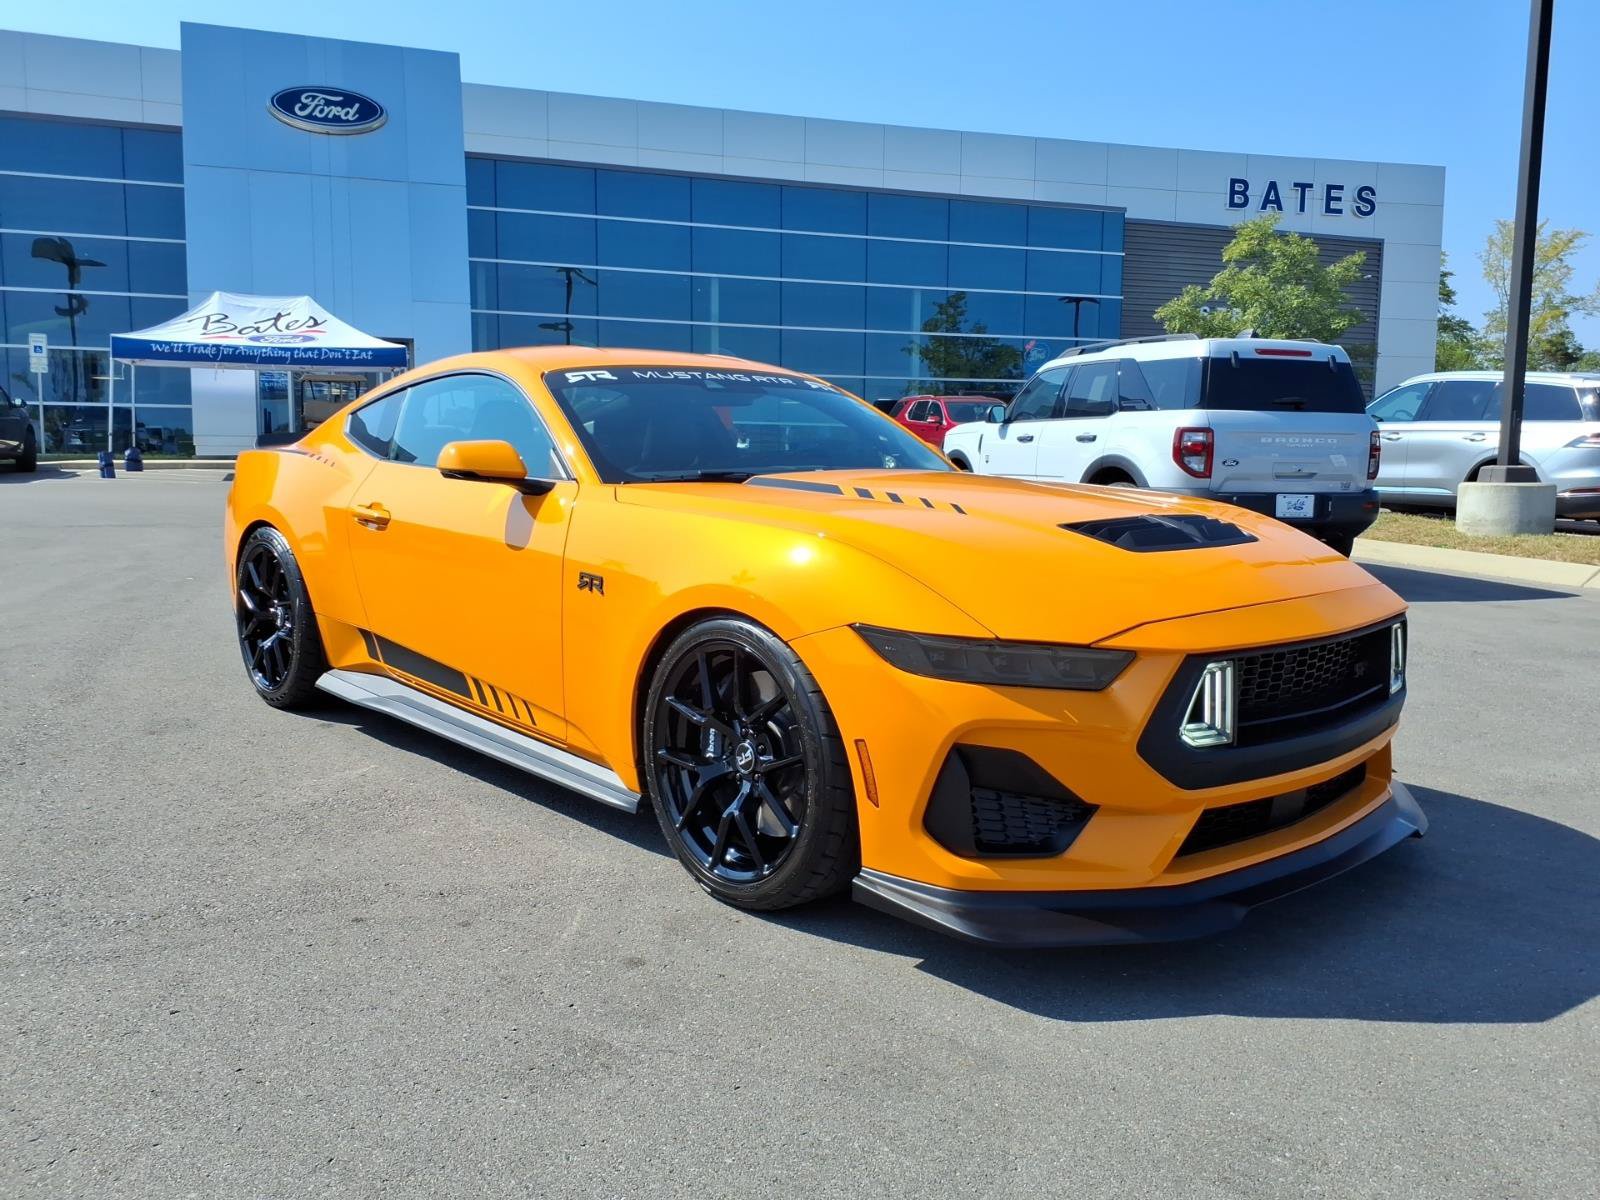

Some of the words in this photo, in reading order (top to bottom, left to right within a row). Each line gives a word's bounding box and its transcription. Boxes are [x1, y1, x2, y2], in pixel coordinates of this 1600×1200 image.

[294, 92, 360, 121] Ford
[1227, 177, 1377, 217] BATES
[187, 312, 328, 335] Bates
[150, 342, 184, 353] We'll
[187, 343, 218, 358] Trade
[217, 345, 233, 361] for
[235, 345, 291, 364] Anything
[294, 346, 320, 359] that
[320, 348, 351, 360] Don't
[351, 349, 374, 361] Eat
[632, 370, 751, 382] MUSTANG
[752, 374, 798, 386] RTR
[1260, 436, 1338, 444] BRONCO
